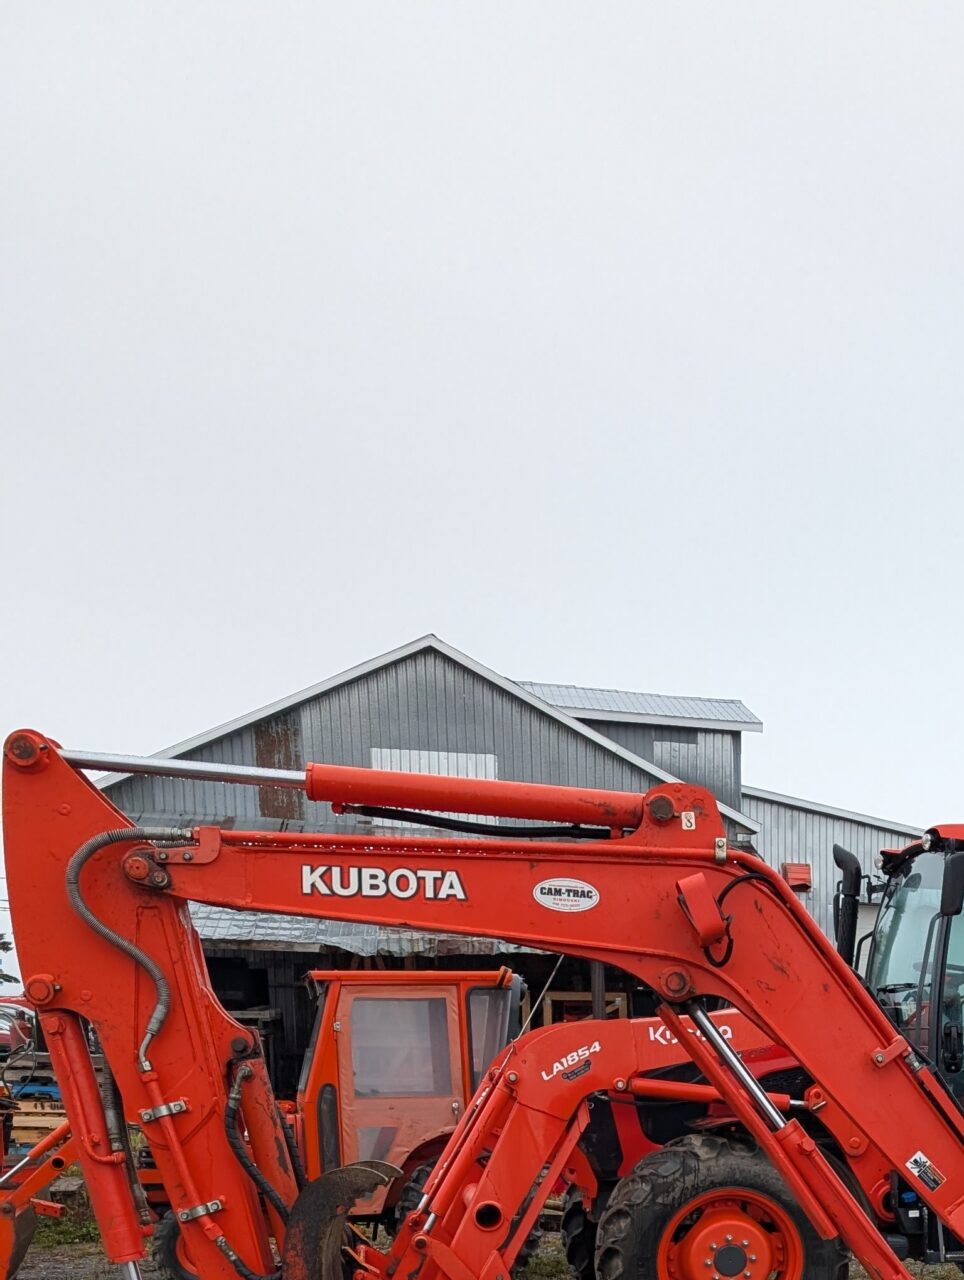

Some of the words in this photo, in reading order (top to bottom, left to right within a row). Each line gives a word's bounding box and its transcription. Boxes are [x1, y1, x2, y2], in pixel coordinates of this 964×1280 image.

[301, 865, 467, 900] KUBOTA
[540, 887, 594, 899] CAM-TRAC
[541, 1041, 602, 1081] LA1854
